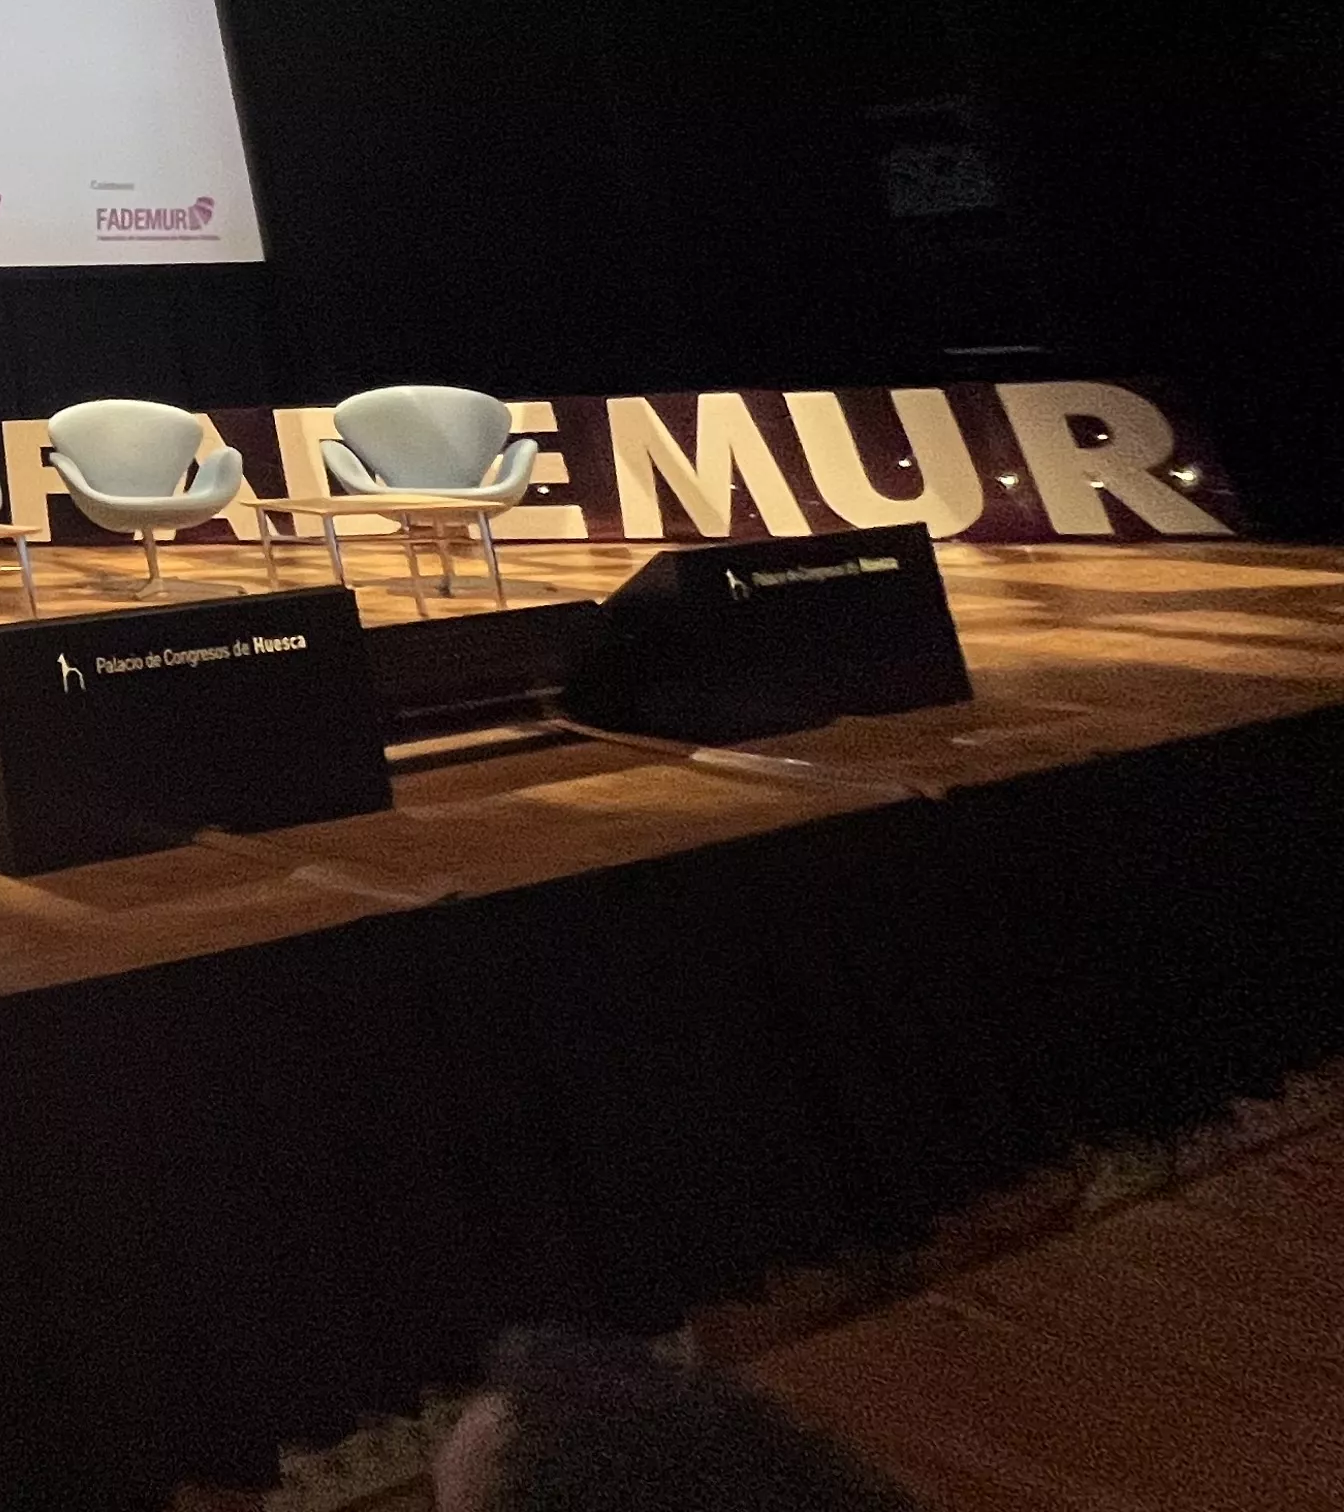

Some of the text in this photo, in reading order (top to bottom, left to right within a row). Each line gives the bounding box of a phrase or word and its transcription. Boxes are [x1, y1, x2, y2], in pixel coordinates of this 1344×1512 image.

[96, 208, 188, 231] FADEMUR
[96, 634, 307, 675] Palacio de Congresos de Huesca
